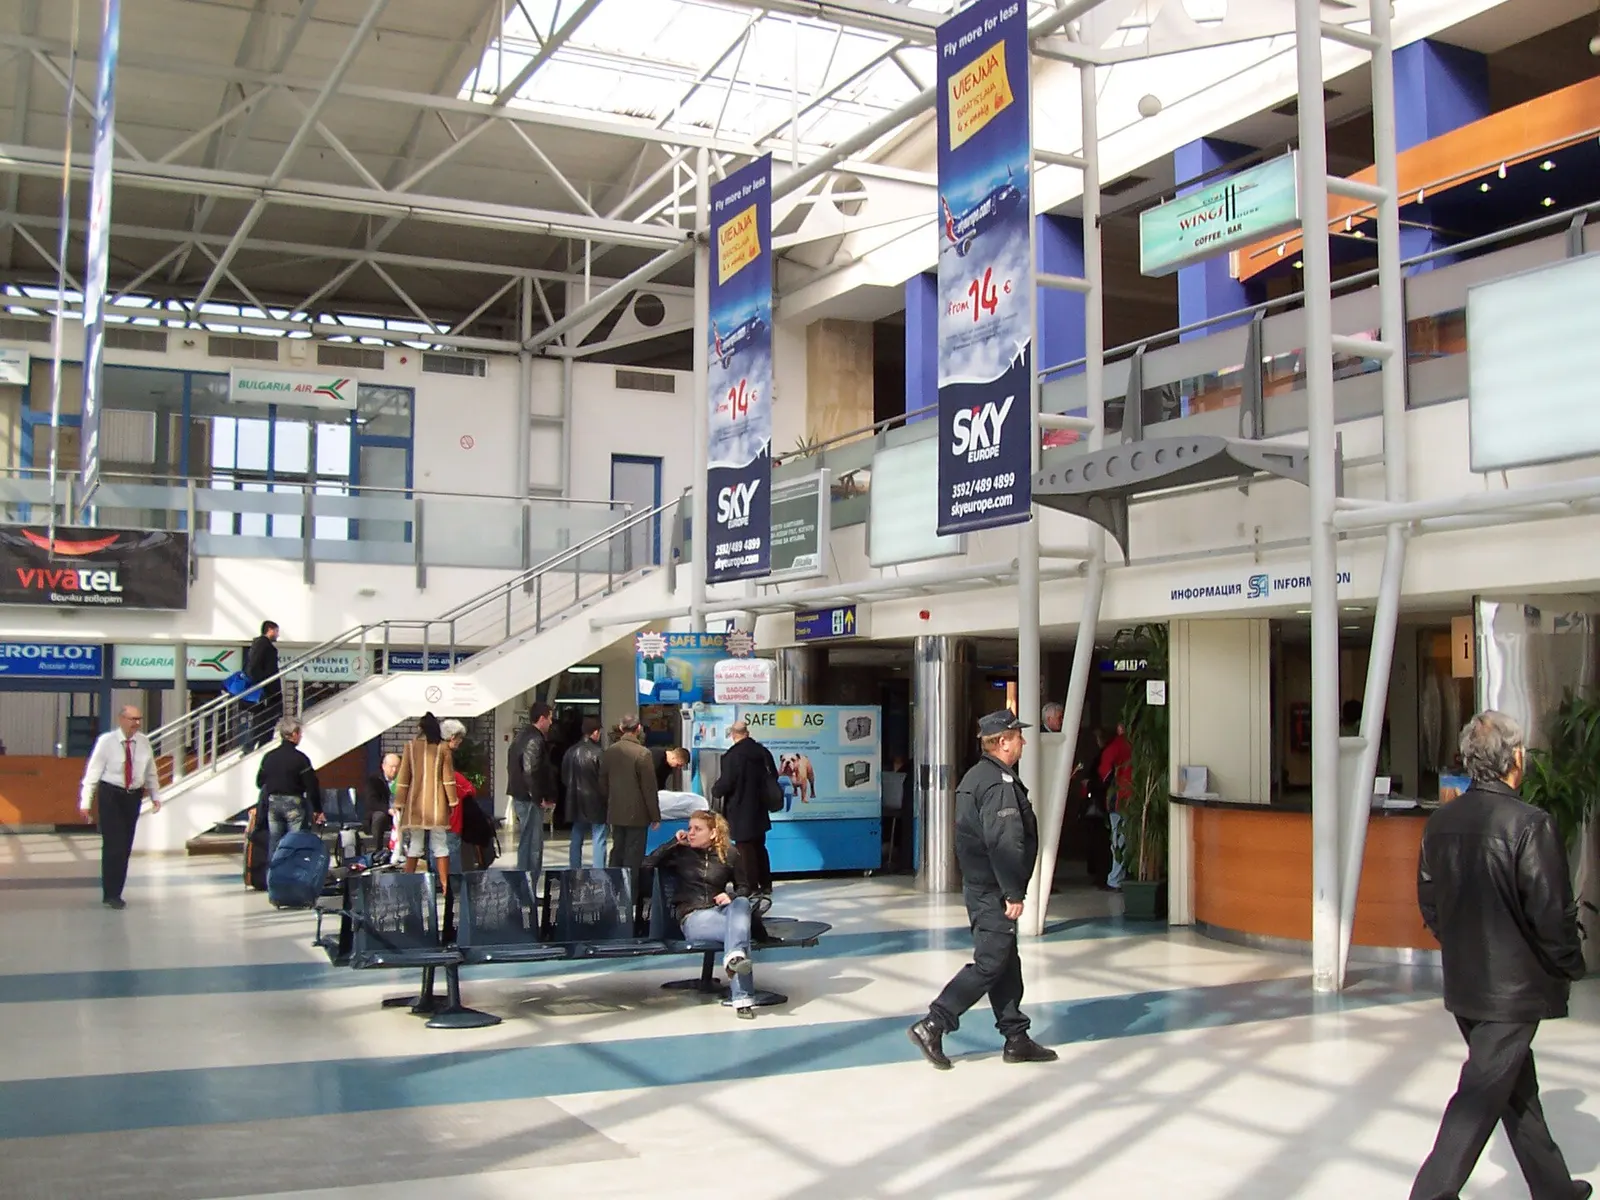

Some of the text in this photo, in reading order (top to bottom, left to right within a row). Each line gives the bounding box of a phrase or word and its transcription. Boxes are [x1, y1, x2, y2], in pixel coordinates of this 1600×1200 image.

[943, 2, 1019, 57] Fly more for less
[953, 54, 999, 101] VIENNA
[715, 176, 766, 212] Fly more for less
[1180, 204, 1224, 231] WINGS
[1194, 231, 1221, 247] COFFEE
[1227, 223, 1242, 235] BAR
[947, 267, 1011, 321] from 14 €
[238, 379, 313, 393] BULGARIA AIR
[728, 379, 748, 420] 14
[952, 395, 1014, 456] SKY
[967, 445, 1000, 463] EUROPE
[952, 472, 1015, 499] 3592/489 4899
[717, 479, 760, 523] SKY
[951, 494, 1013, 517] skyeurope.com
[727, 516, 749, 529] EUROPE
[714, 554, 759, 571] skyeurope.com
[1170, 584, 1242, 600] ИНФОРМАЦИЯ
[669, 635, 697, 647] SAFE
[700, 635, 723, 648] BAG
[120, 657, 174, 667] BULGARIA
[744, 713, 776, 726] SAFE
